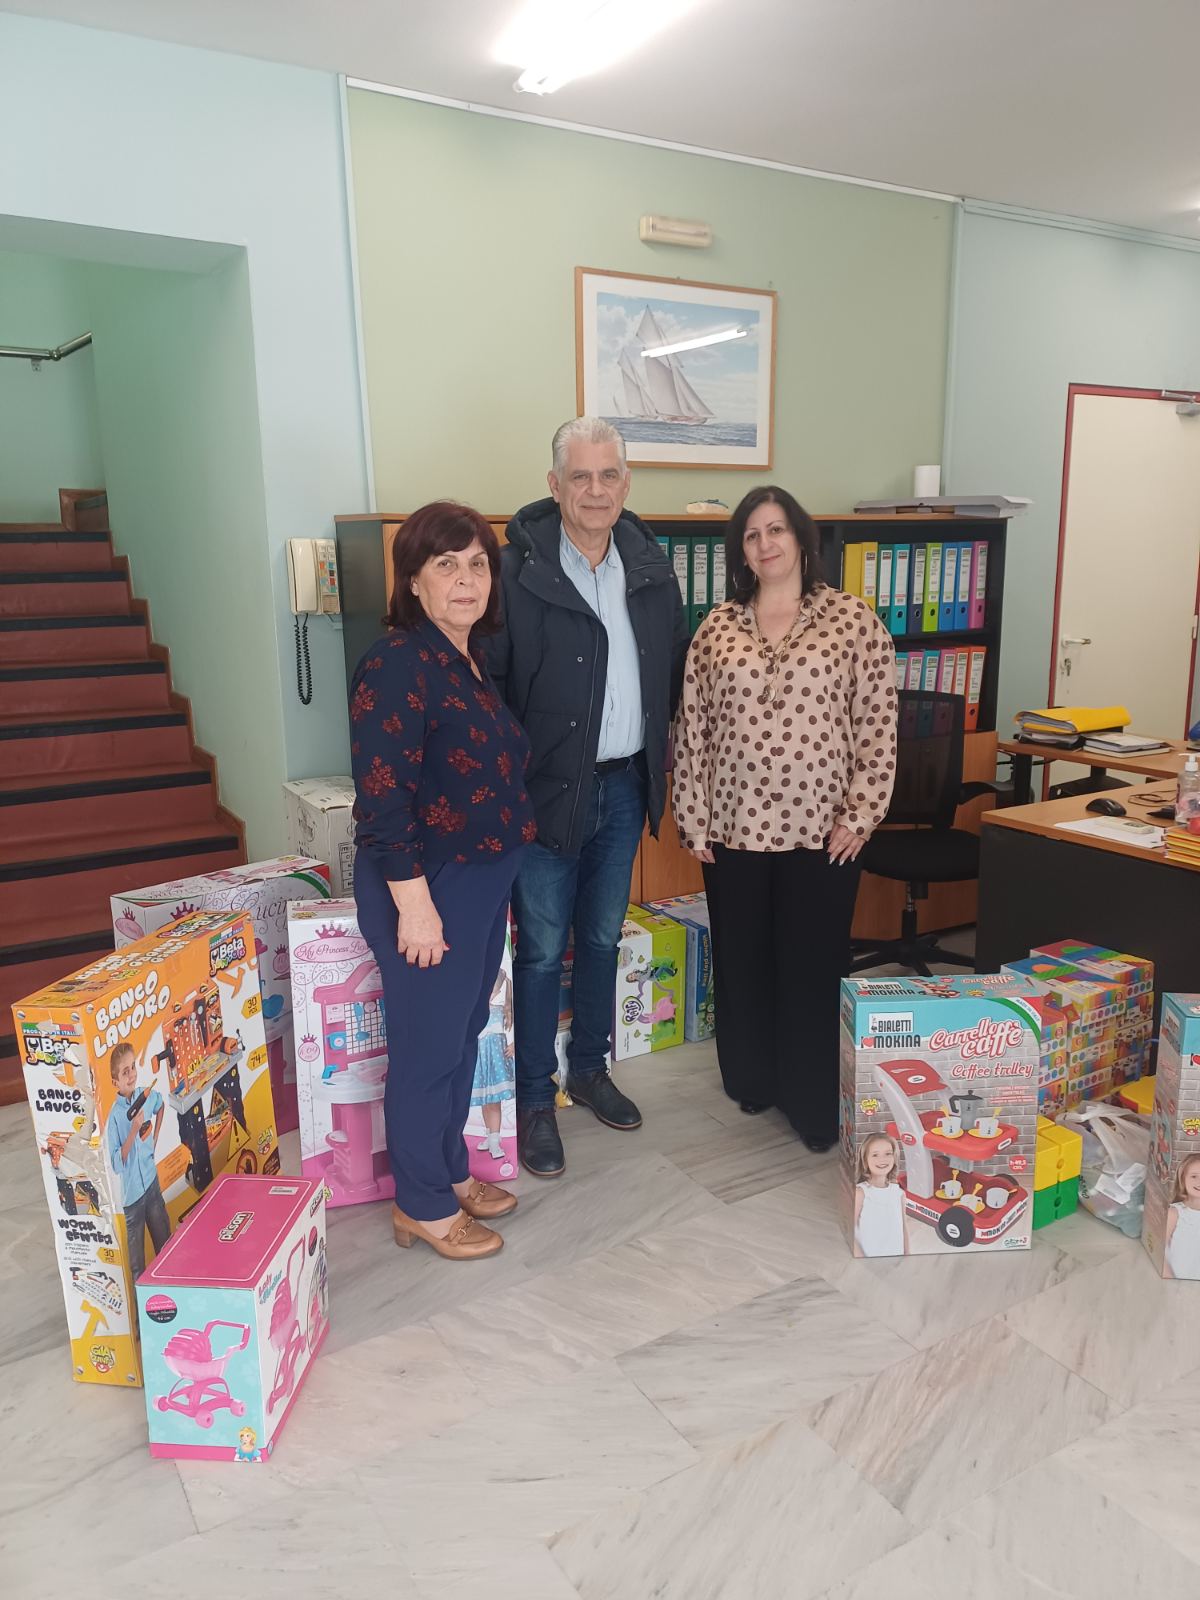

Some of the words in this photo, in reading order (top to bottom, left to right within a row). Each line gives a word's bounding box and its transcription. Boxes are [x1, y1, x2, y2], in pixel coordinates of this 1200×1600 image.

[220, 938, 244, 959] Beta
[96, 971, 158, 1030] BANCO
[247, 997, 256, 1009] 30
[94, 986, 170, 1058] LAVORO
[874, 1034, 921, 1049] MOKINA
[929, 1017, 997, 1052] Carrello
[952, 1063, 991, 1081] Coffee
[994, 1062, 1033, 1078] trolley
[38, 1089, 81, 1101] BANCO
[35, 1101, 85, 1114] LAVOR
[58, 1219, 96, 1231] WORK
[66, 1229, 113, 1245] CENTER
[104, 1248, 115, 1258] 30
